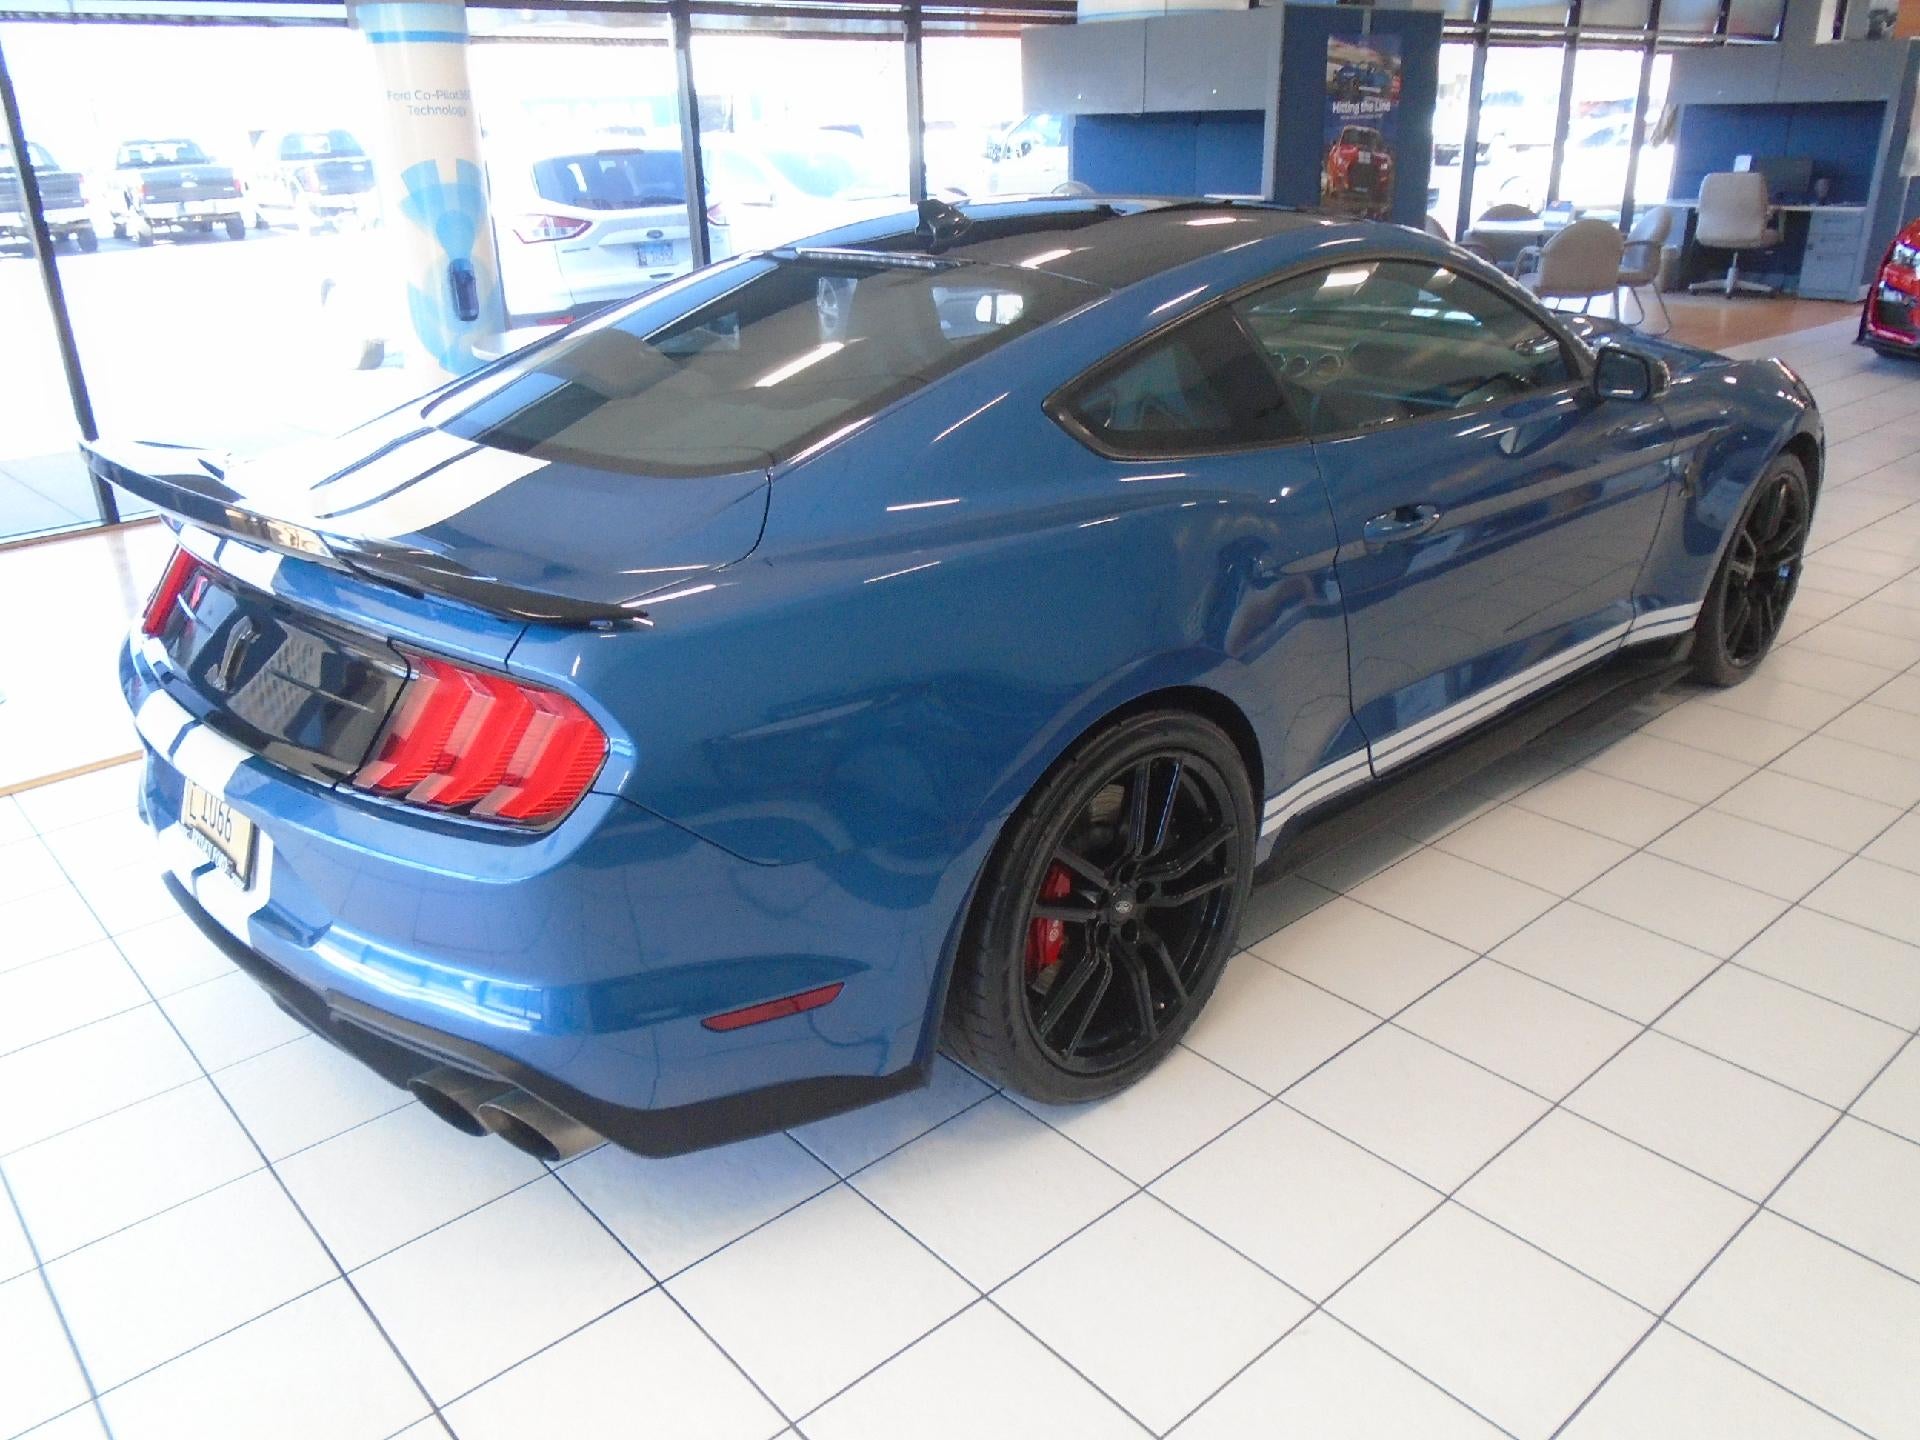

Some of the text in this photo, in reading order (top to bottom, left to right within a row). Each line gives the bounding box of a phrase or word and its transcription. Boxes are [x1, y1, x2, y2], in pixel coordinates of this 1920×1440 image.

[387, 90, 411, 101] Ford
[407, 104, 466, 117] Technology
[1361, 100, 1374, 112] the
[1374, 100, 1391, 112] Line
